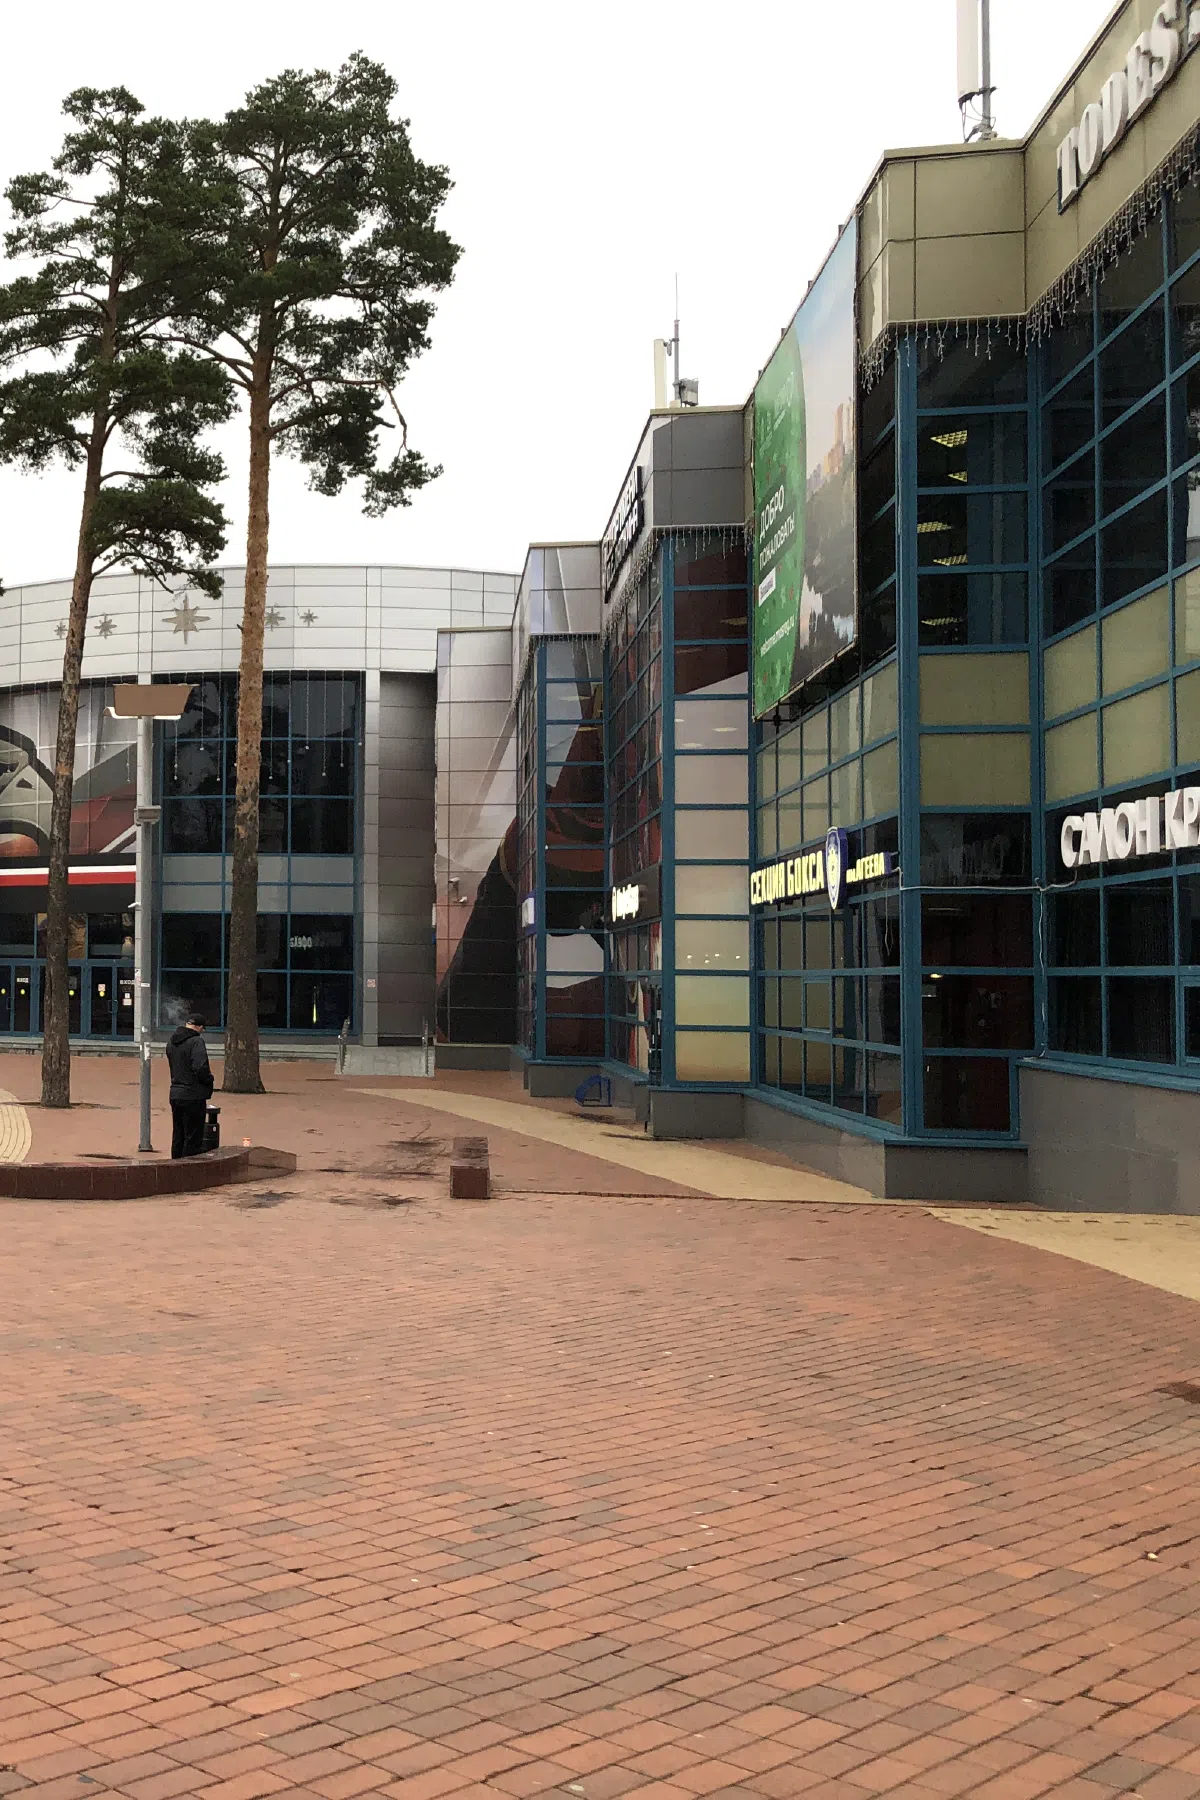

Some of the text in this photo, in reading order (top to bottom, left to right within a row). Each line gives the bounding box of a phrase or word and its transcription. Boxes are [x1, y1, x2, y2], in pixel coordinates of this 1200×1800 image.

[759, 484, 785, 543] ДОБРО
[1061, 786, 1200, 868] САЛОН КР
[751, 862, 786, 905] СЕКЦИЯ
[787, 851, 825, 896] БОКСА
